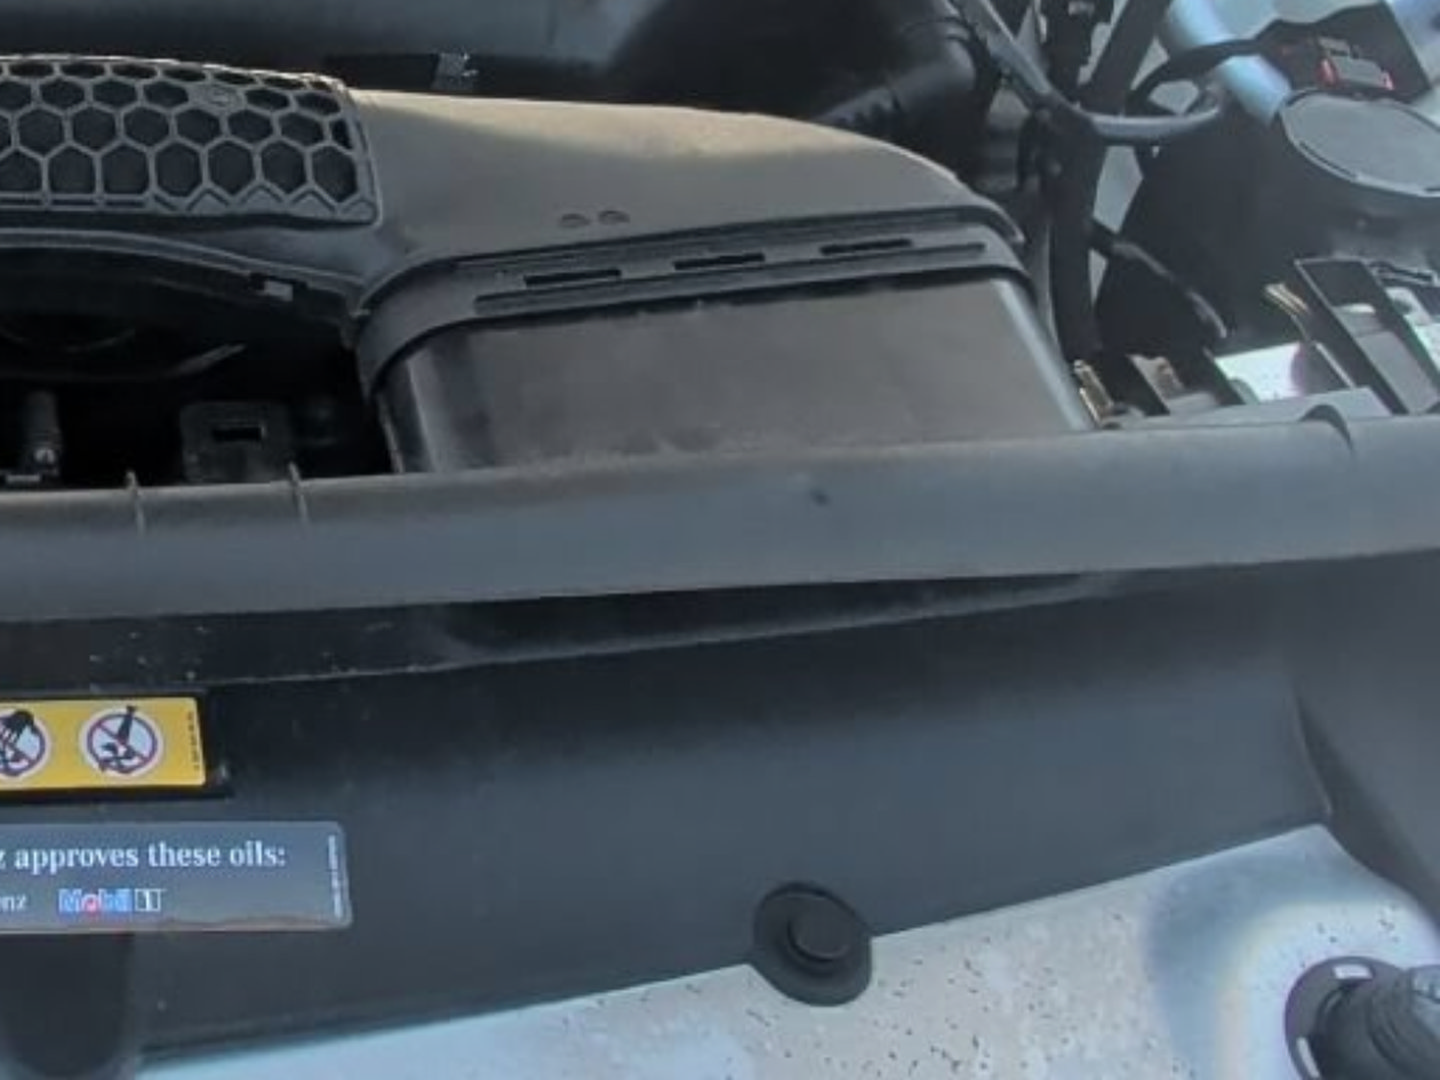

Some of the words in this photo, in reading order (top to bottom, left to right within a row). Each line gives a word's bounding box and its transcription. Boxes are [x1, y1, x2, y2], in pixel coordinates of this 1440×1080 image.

[14, 844, 139, 875] approves
[148, 840, 221, 867] these
[229, 840, 287, 866] oils:
